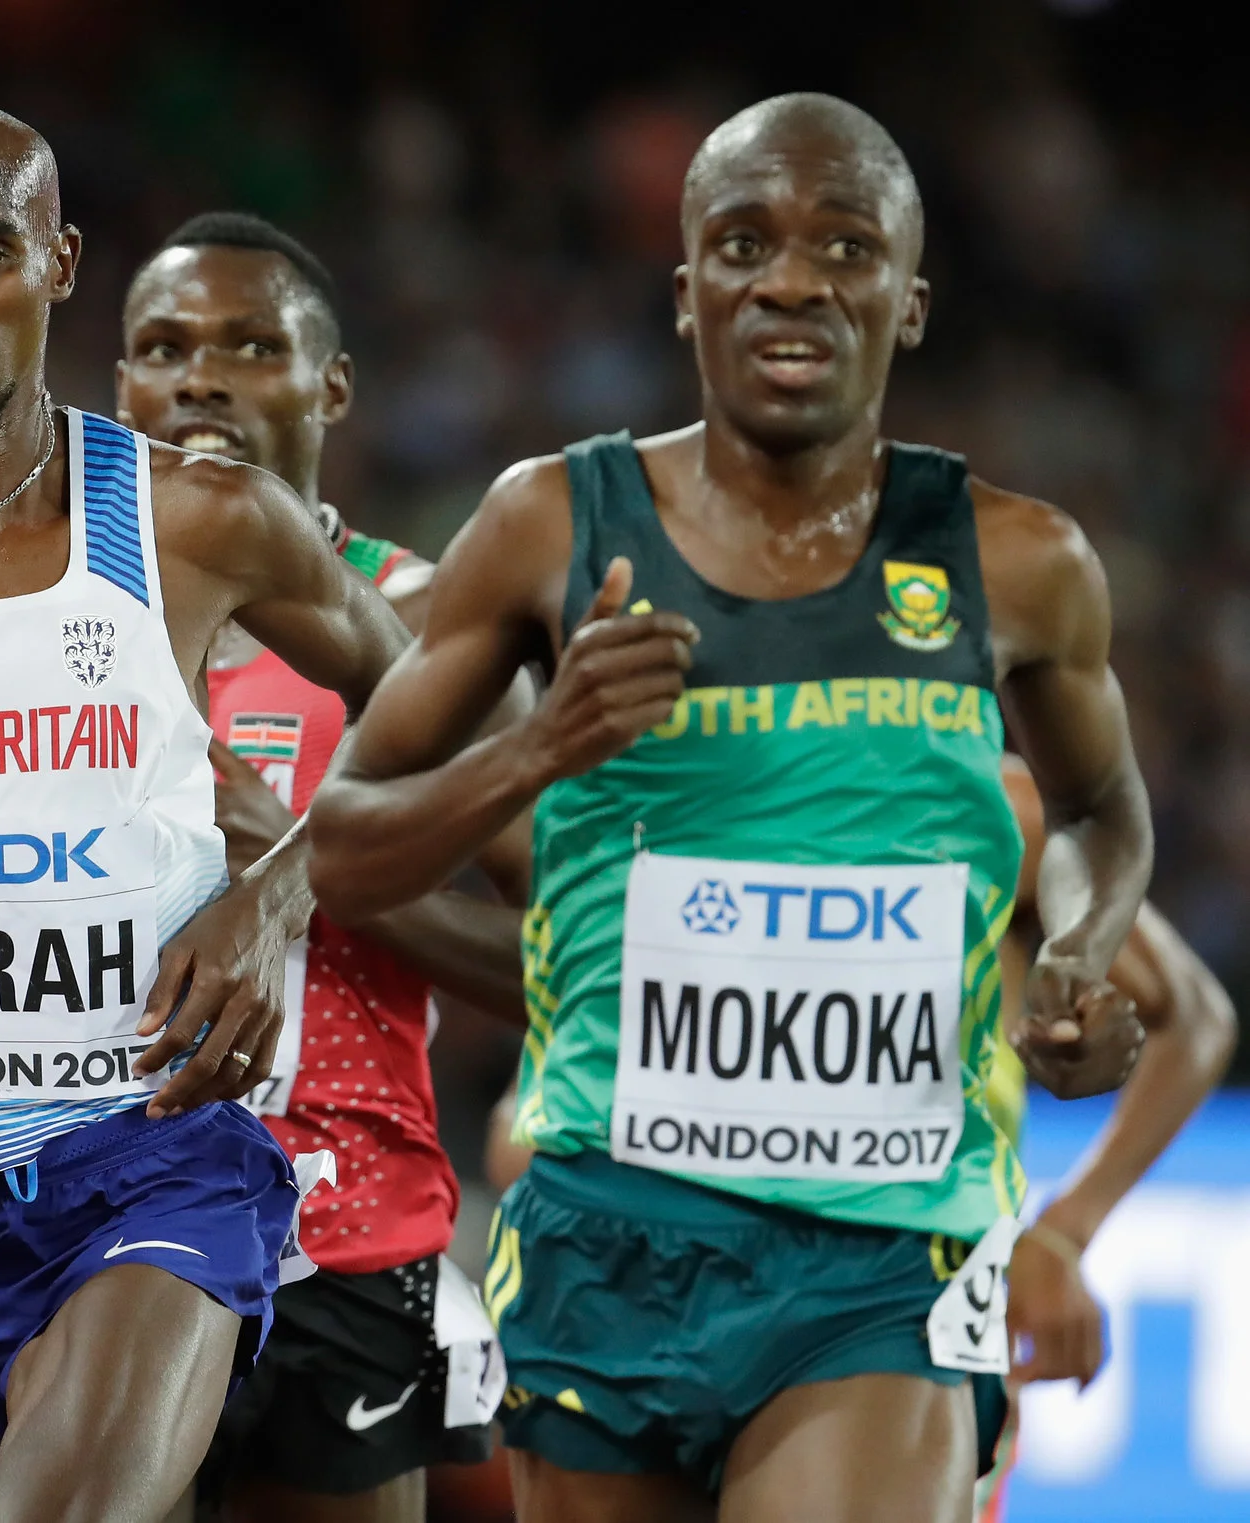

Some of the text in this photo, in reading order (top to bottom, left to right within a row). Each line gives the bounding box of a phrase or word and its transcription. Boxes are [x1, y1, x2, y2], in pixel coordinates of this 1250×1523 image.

[652, 677, 984, 740] UTH AFRICA
[743, 883, 923, 942] TDK
[639, 979, 944, 1086] MOKOKA
[626, 1114, 951, 1168] LONDON 2017
